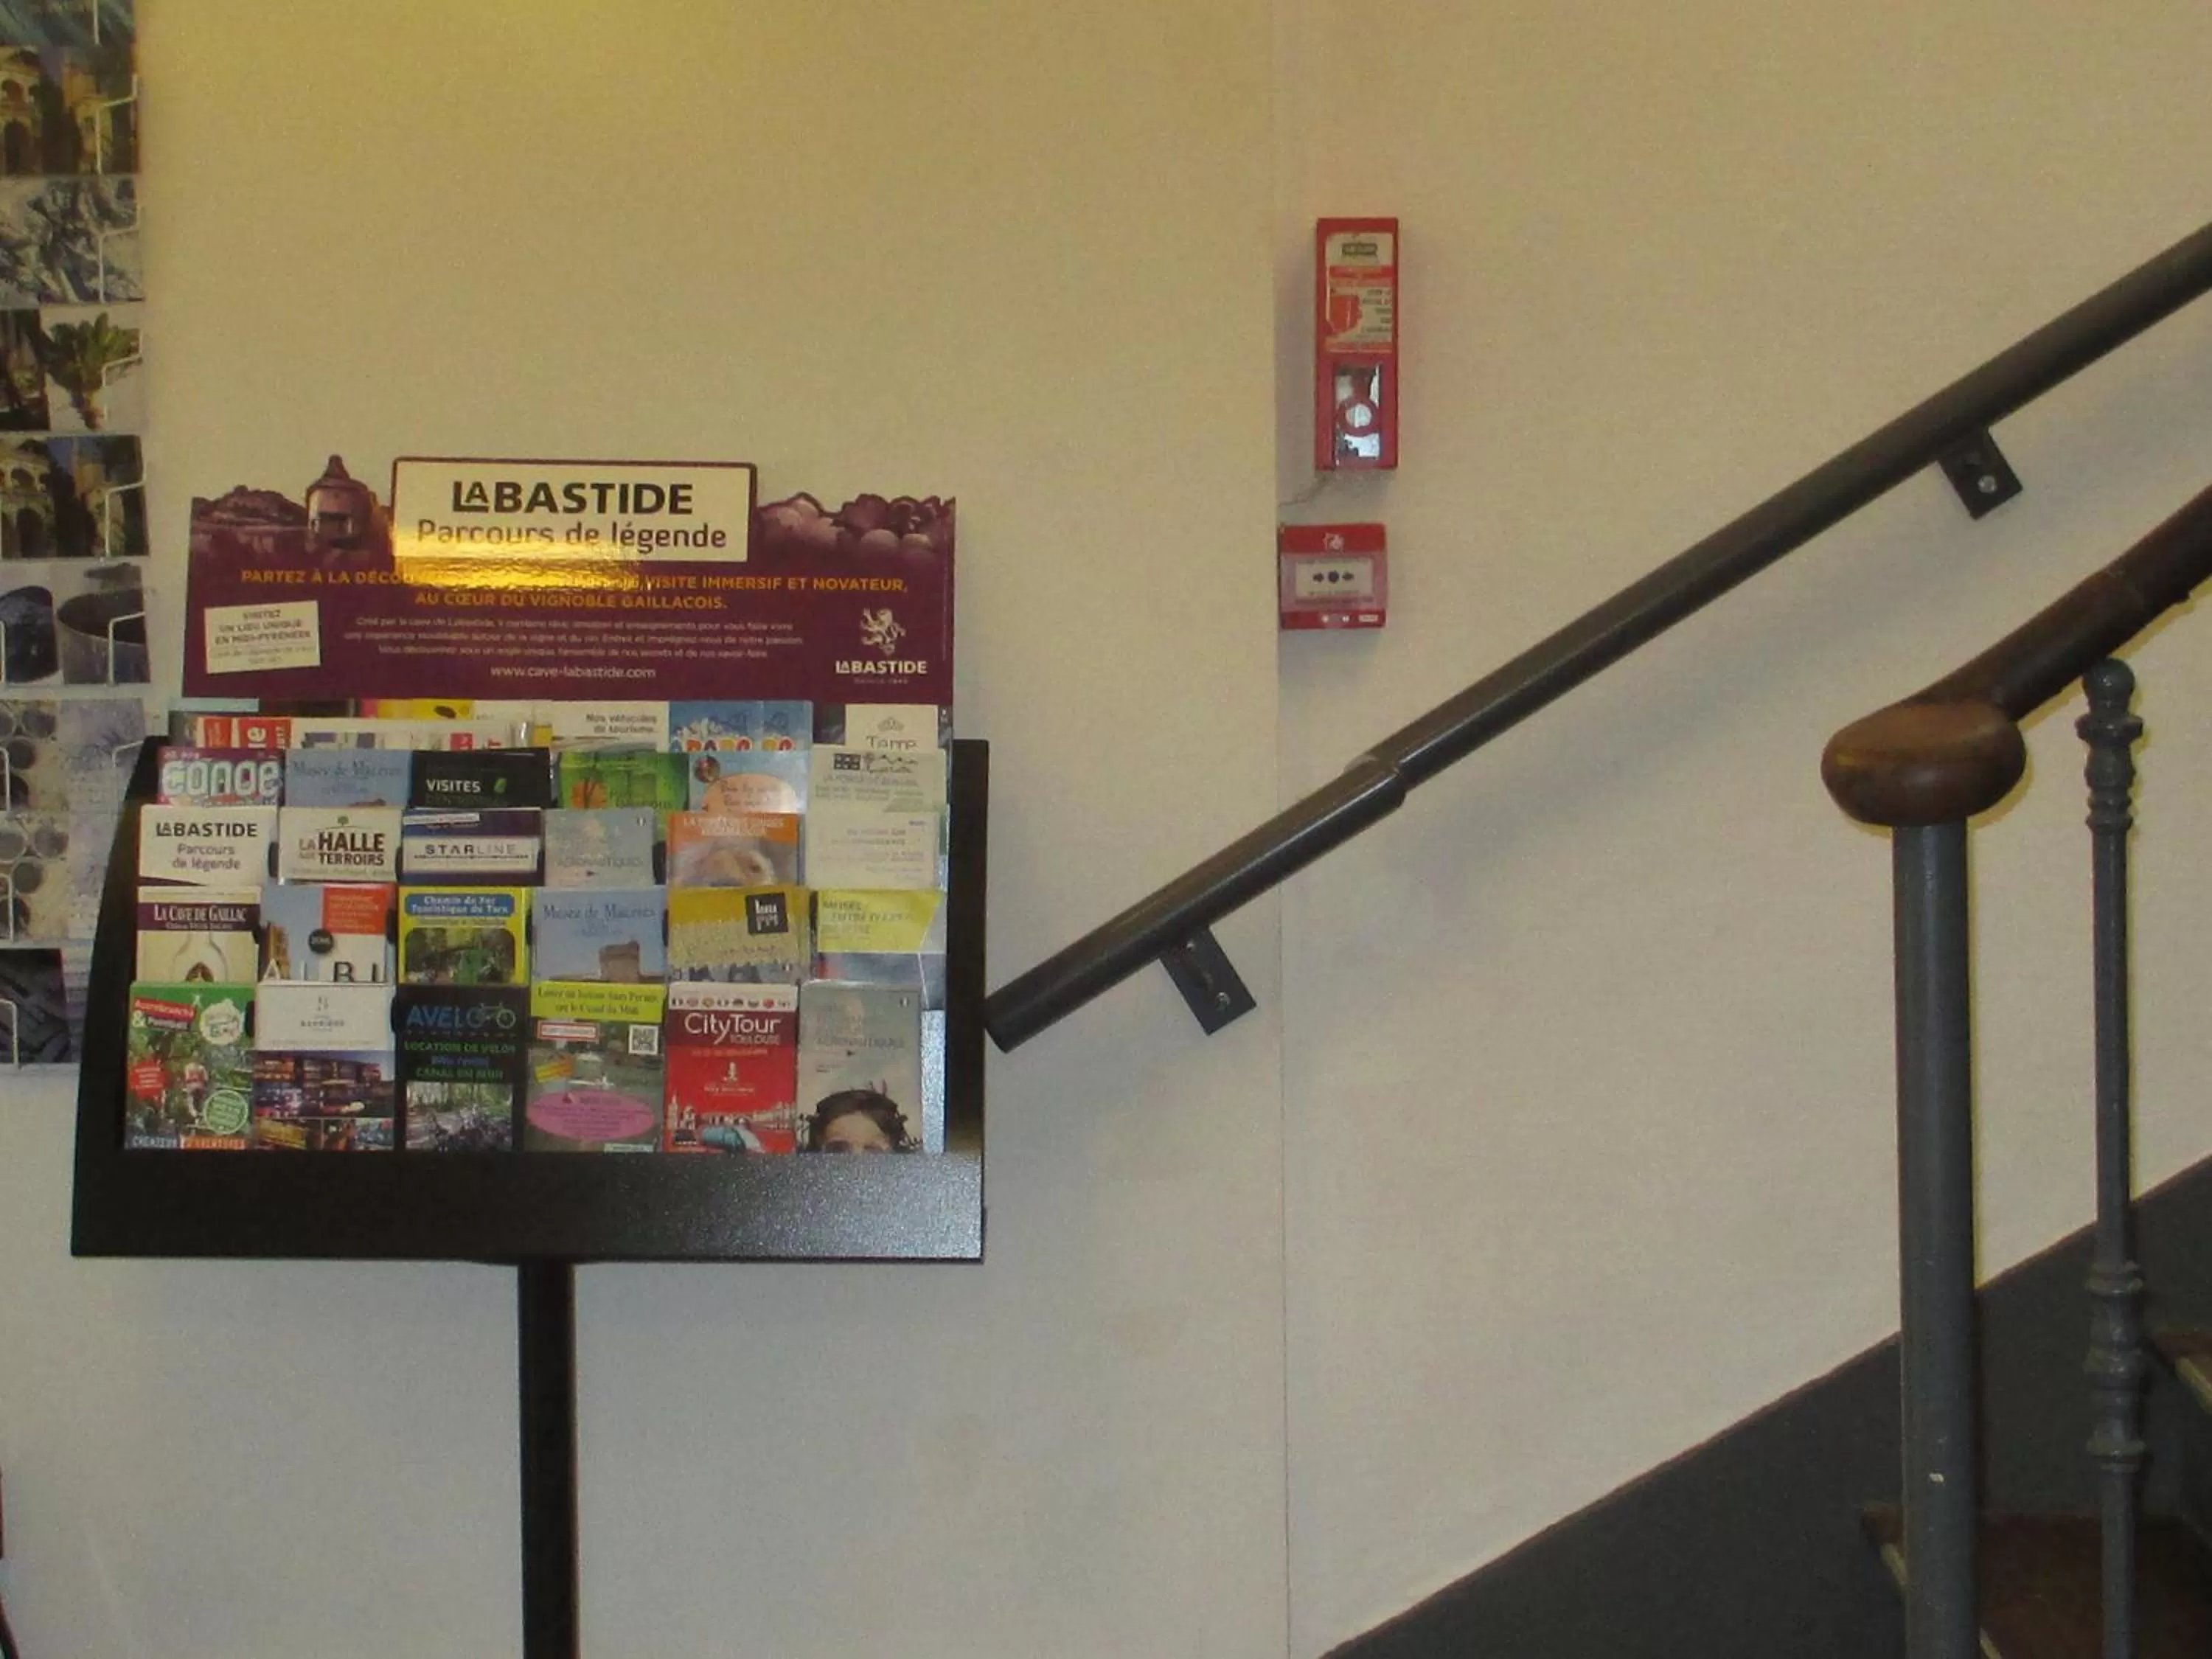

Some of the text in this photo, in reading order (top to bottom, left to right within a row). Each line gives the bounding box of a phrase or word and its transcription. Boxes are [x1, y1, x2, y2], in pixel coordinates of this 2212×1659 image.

[452, 480, 693, 515] LABASTIDE
[417, 518, 727, 554] Parcours de légende
[241, 568, 305, 584] PARTEZ
[310, 566, 323, 585] À
[328, 571, 350, 585] LA
[646, 574, 698, 589] VISITE
[702, 575, 782, 590] IMMERSIF
[787, 577, 807, 590] ET
[813, 577, 908, 593] NOVATEUR,
[414, 591, 728, 610] AU CŒUR DU VIGNOBLE GAILLACOIS.
[490, 666, 656, 679] www.cave-labastide.com
[835, 660, 928, 675] LABASTIDE
[425, 778, 481, 793] VISITES
[156, 821, 258, 838] LABASTIDE
[177, 843, 236, 856] Parcours
[299, 831, 386, 852] LA HALLE
[424, 844, 517, 855] STARLINE
[172, 856, 241, 872] de légende
[318, 852, 385, 866] TERROIRS
[684, 1012, 782, 1046] CityTour
